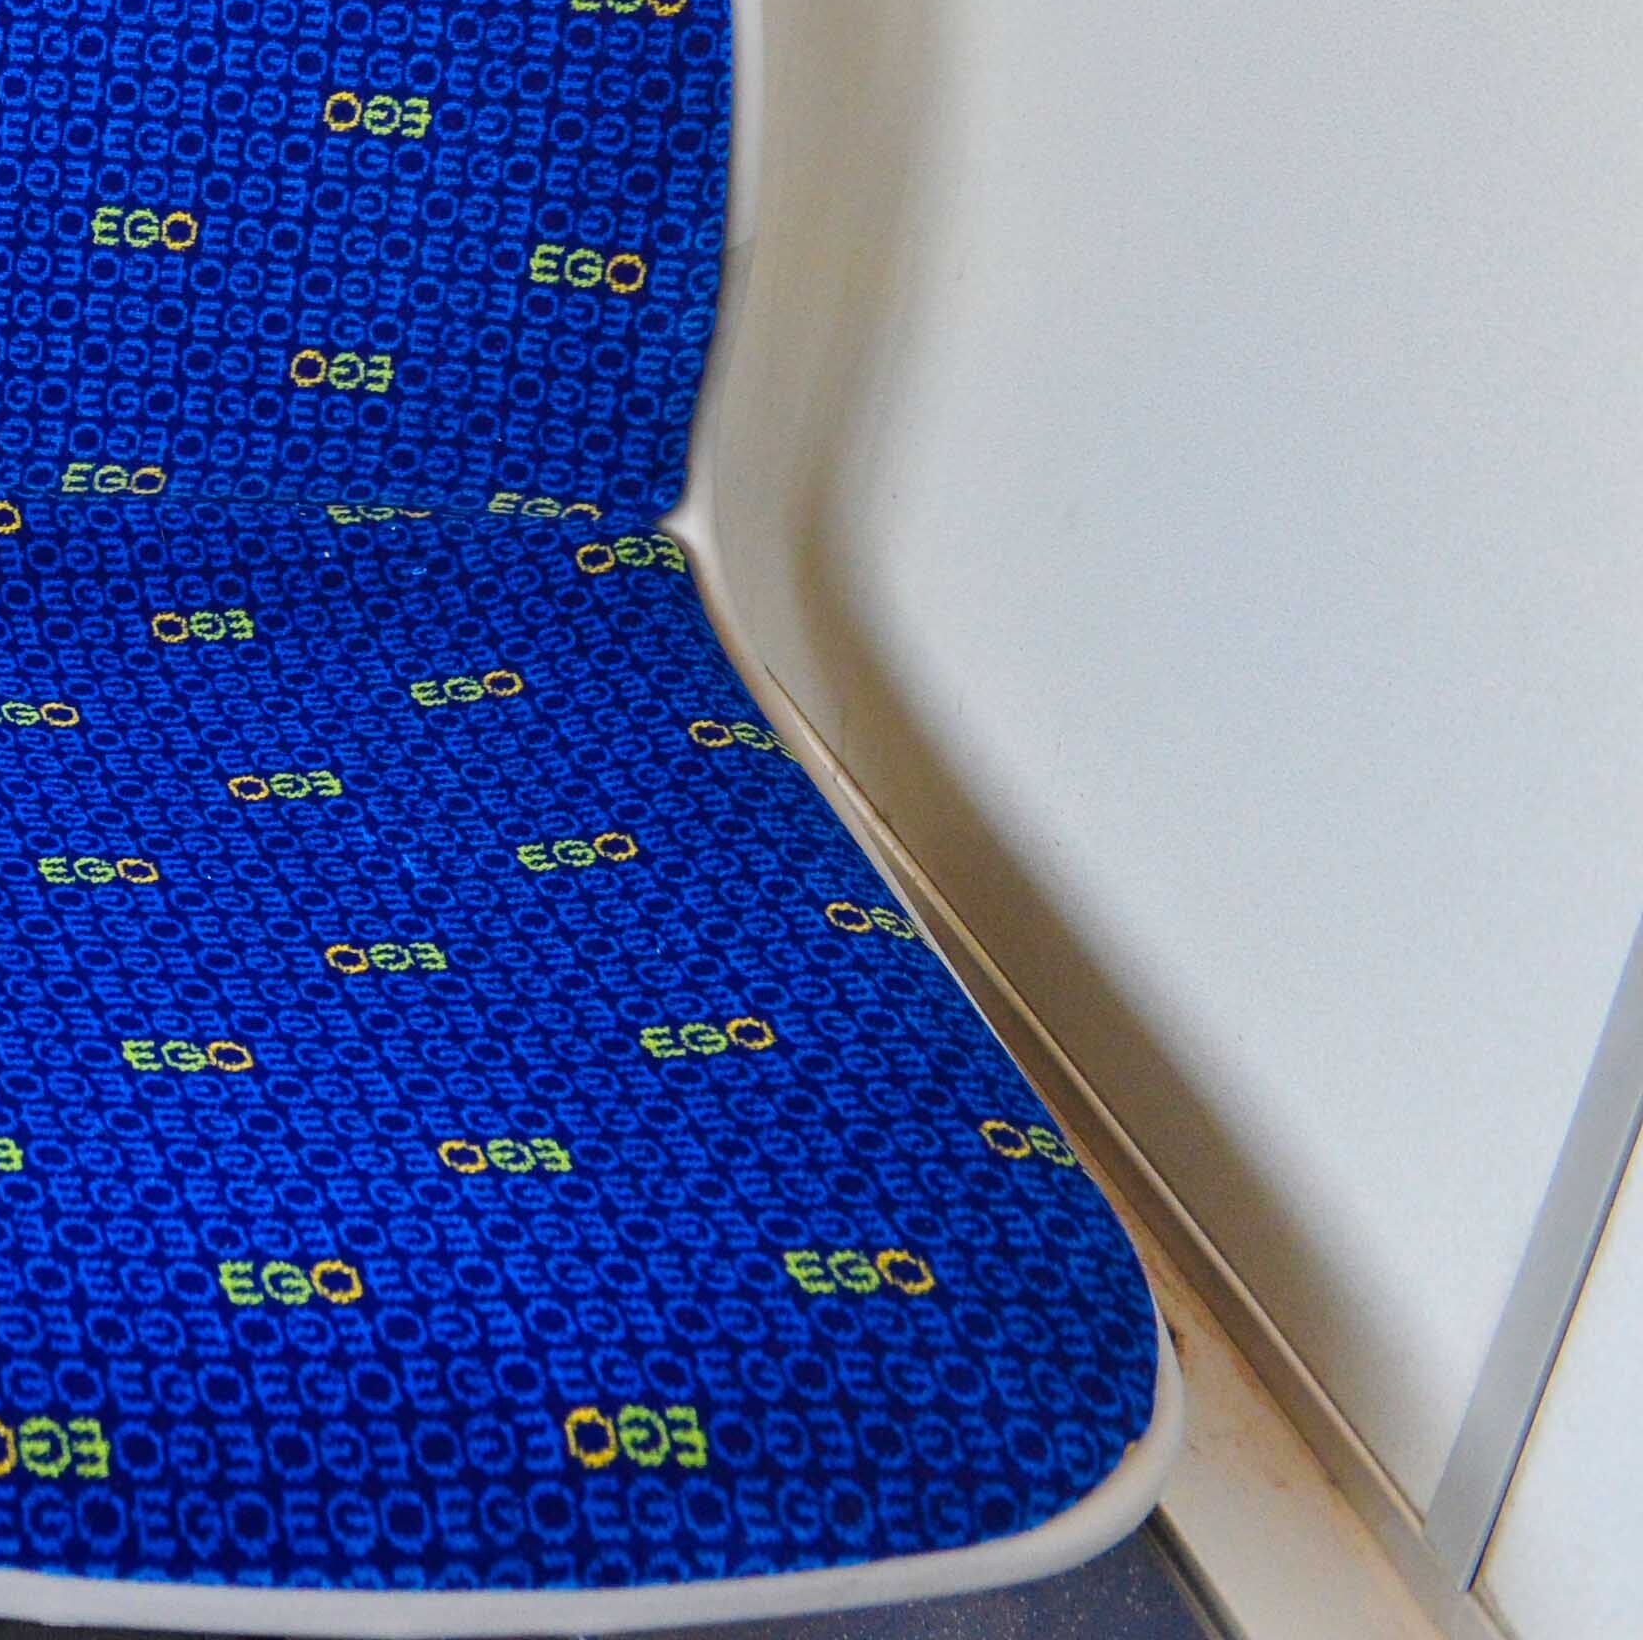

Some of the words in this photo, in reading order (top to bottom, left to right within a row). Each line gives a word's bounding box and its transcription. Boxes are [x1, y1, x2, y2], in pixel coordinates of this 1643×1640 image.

[92, 208, 197, 250] EGO
[531, 245, 646, 293] EGO
[60, 461, 168, 495] EGO
[412, 671, 523, 706] EGO
[40, 858, 159, 883] EGO
[519, 833, 637, 870] EGO
[124, 1041, 253, 1071] EGO
[642, 1018, 774, 1057] EGO
[221, 1261, 363, 1304] EGO
[786, 1251, 935, 1293] EGO
